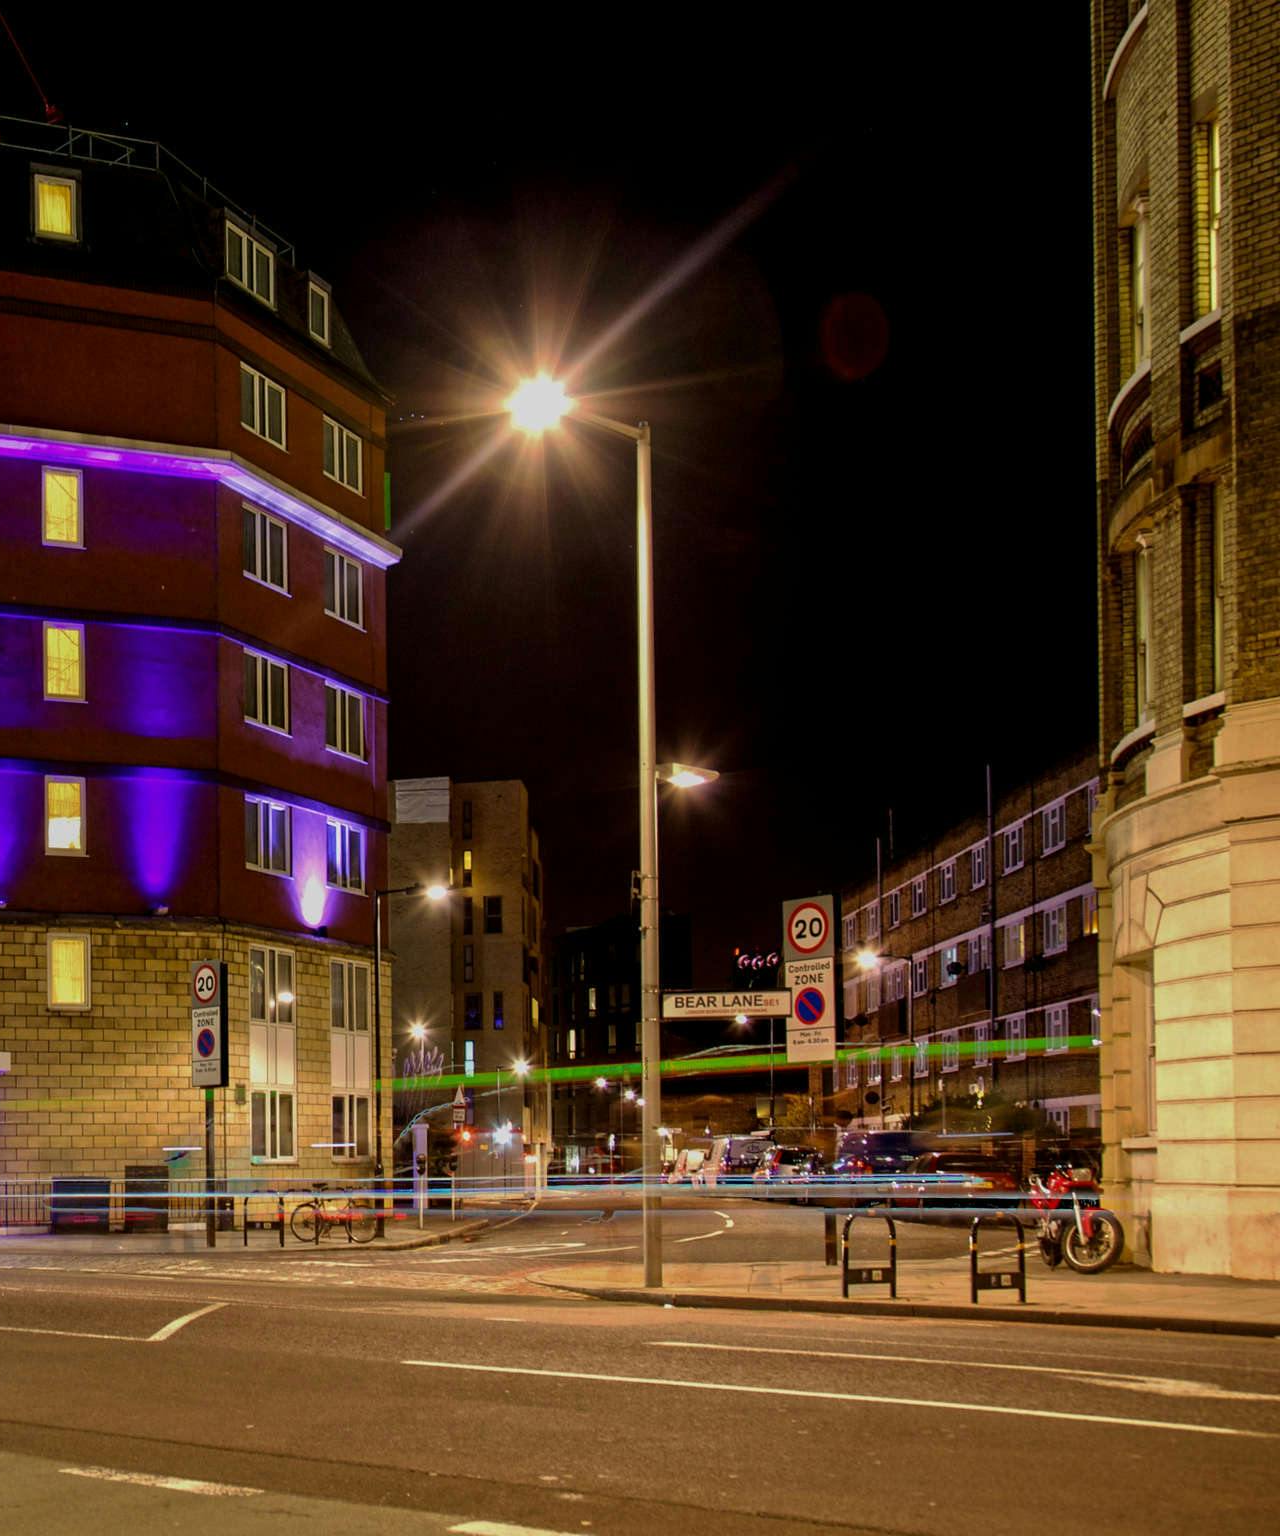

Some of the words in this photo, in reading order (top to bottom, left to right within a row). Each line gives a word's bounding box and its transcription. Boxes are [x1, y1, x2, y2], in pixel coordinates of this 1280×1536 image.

[795, 917, 823, 939] 20
[788, 961, 831, 973] Controlled
[197, 975, 214, 992] 20
[794, 973, 824, 985] ZONE
[674, 996, 717, 1008] BEAR
[722, 994, 763, 1007] LANE
[197, 1018, 214, 1027] ZONE
